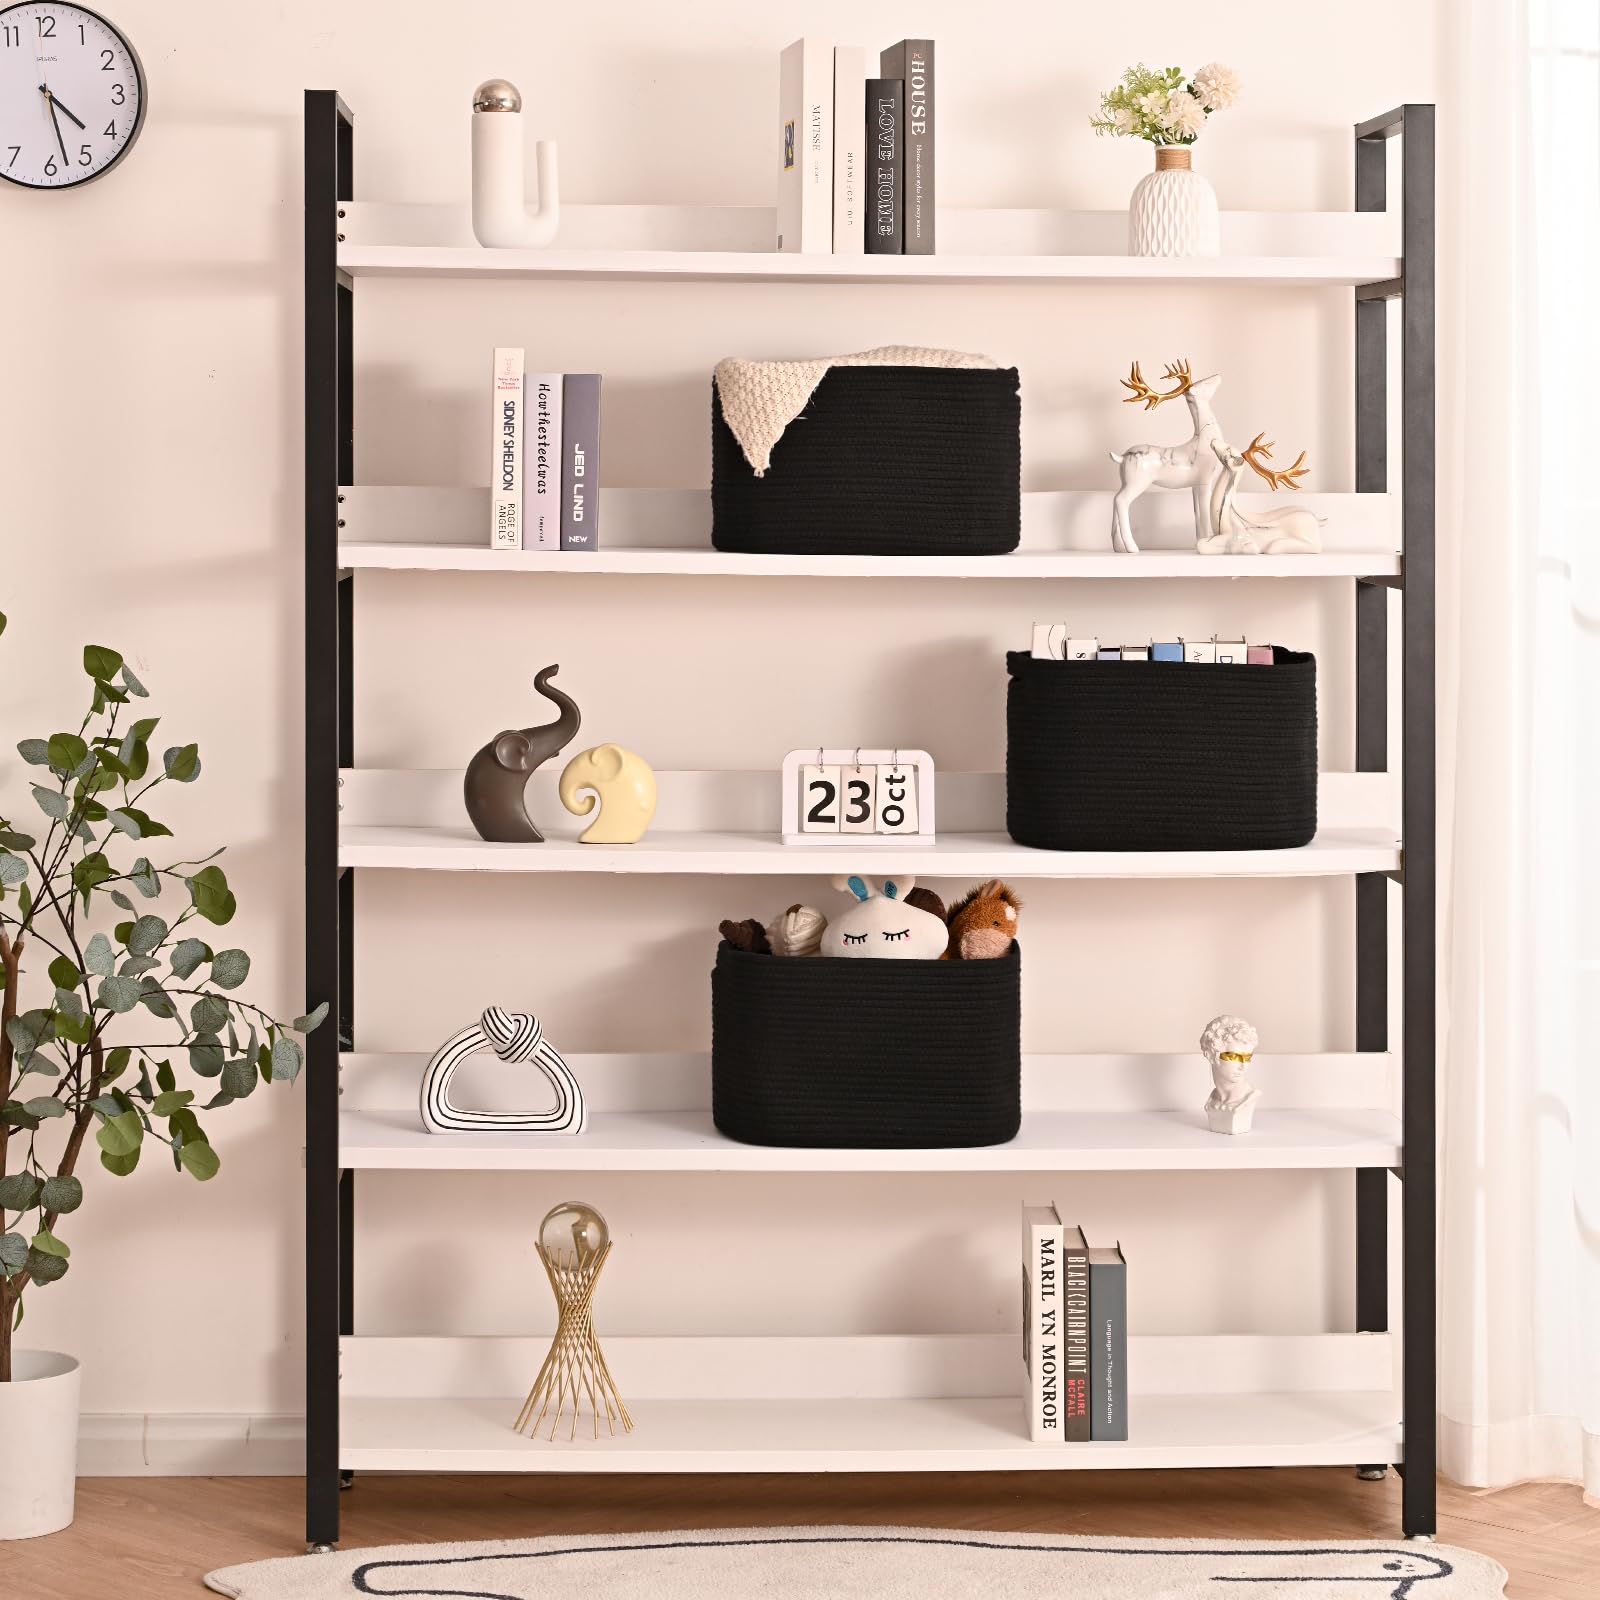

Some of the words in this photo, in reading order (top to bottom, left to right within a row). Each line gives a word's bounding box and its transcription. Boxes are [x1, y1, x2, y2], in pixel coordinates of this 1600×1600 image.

[4, 26, 19, 47] 11
[35, 16, 56, 37] 12
[78, 24, 85, 45] 1
[100, 50, 115, 70] 2
[111, 84, 125, 105] 3
[911, 60, 926, 136] HOUSE
[103, 119, 117, 140] 4
[812, 104, 821, 151] MATISSE
[879, 98, 895, 160] LOVE
[8, 146, 21, 167] 7
[44, 154, 57, 176] 6
[78, 145, 92, 166] 5
[878, 168, 894, 236] HOME
[503, 400, 515, 438] SIDNEY
[503, 440, 514, 491] SHELDON
[574, 443, 585, 477] JED
[573, 483, 584, 522] LIND
[499, 504, 507, 540] ANGELS
[507, 530, 515, 543] OF
[568, 535, 588, 543] NEW
[1040, 1238, 1055, 1302] MARIL
[1041, 1309, 1056, 1337] YN
[1105, 1319, 1113, 1352] Language
[1042, 1344, 1057, 1429] MONROE
[1105, 1360, 1113, 1388] Thought
[1067, 1379, 1076, 1418] MCFALL
[1077, 1379, 1086, 1416] CLAIRE
